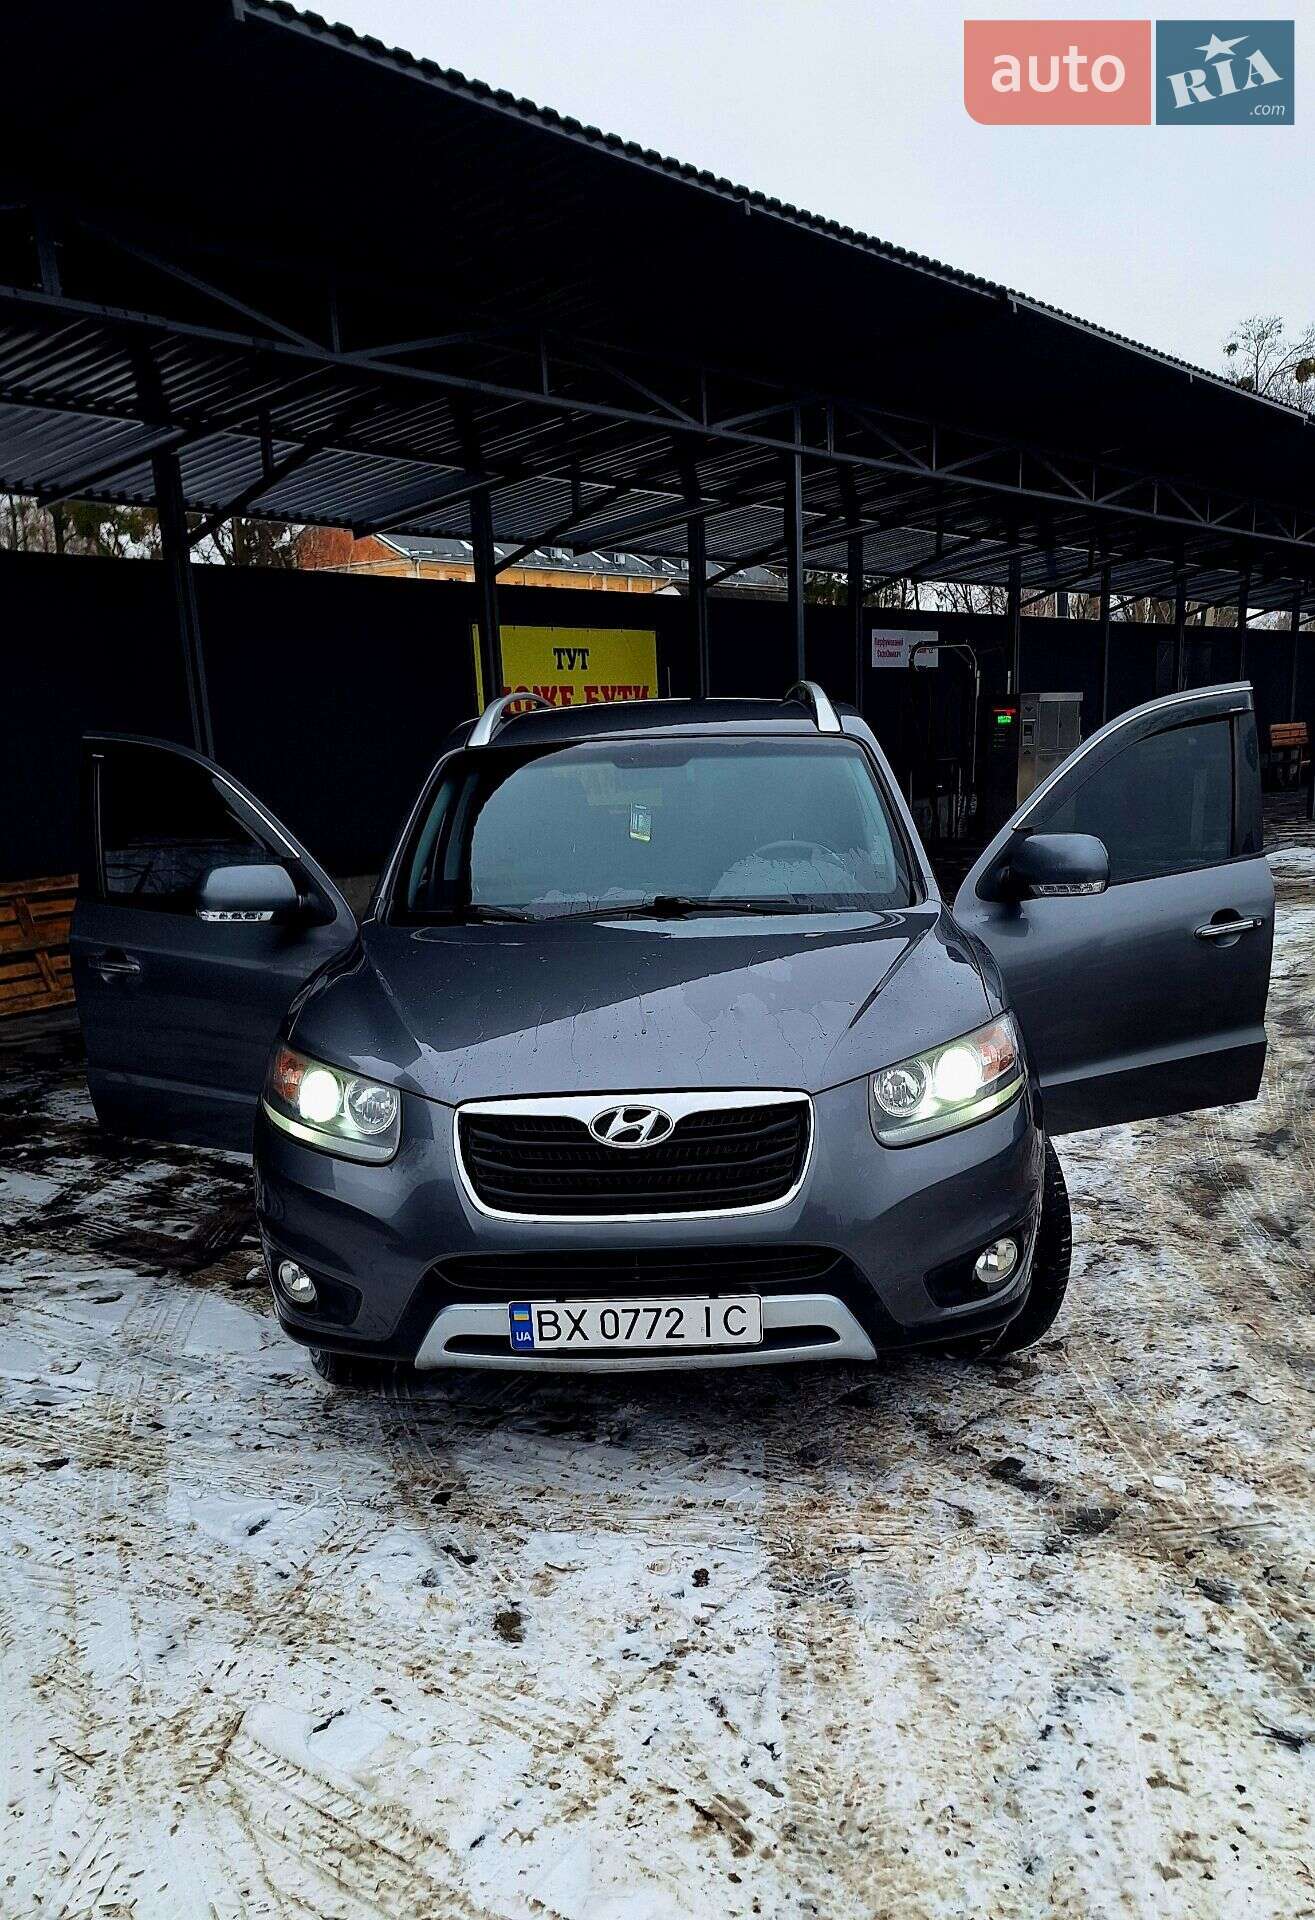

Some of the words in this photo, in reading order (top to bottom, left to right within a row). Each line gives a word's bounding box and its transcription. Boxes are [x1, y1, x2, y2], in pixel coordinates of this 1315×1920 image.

[552, 647, 590, 670] ТУТ
[536, 1309, 590, 1342] BX
[599, 1307, 685, 1340] 0772
[704, 1304, 748, 1338] IC
[516, 1331, 532, 1342] UA
